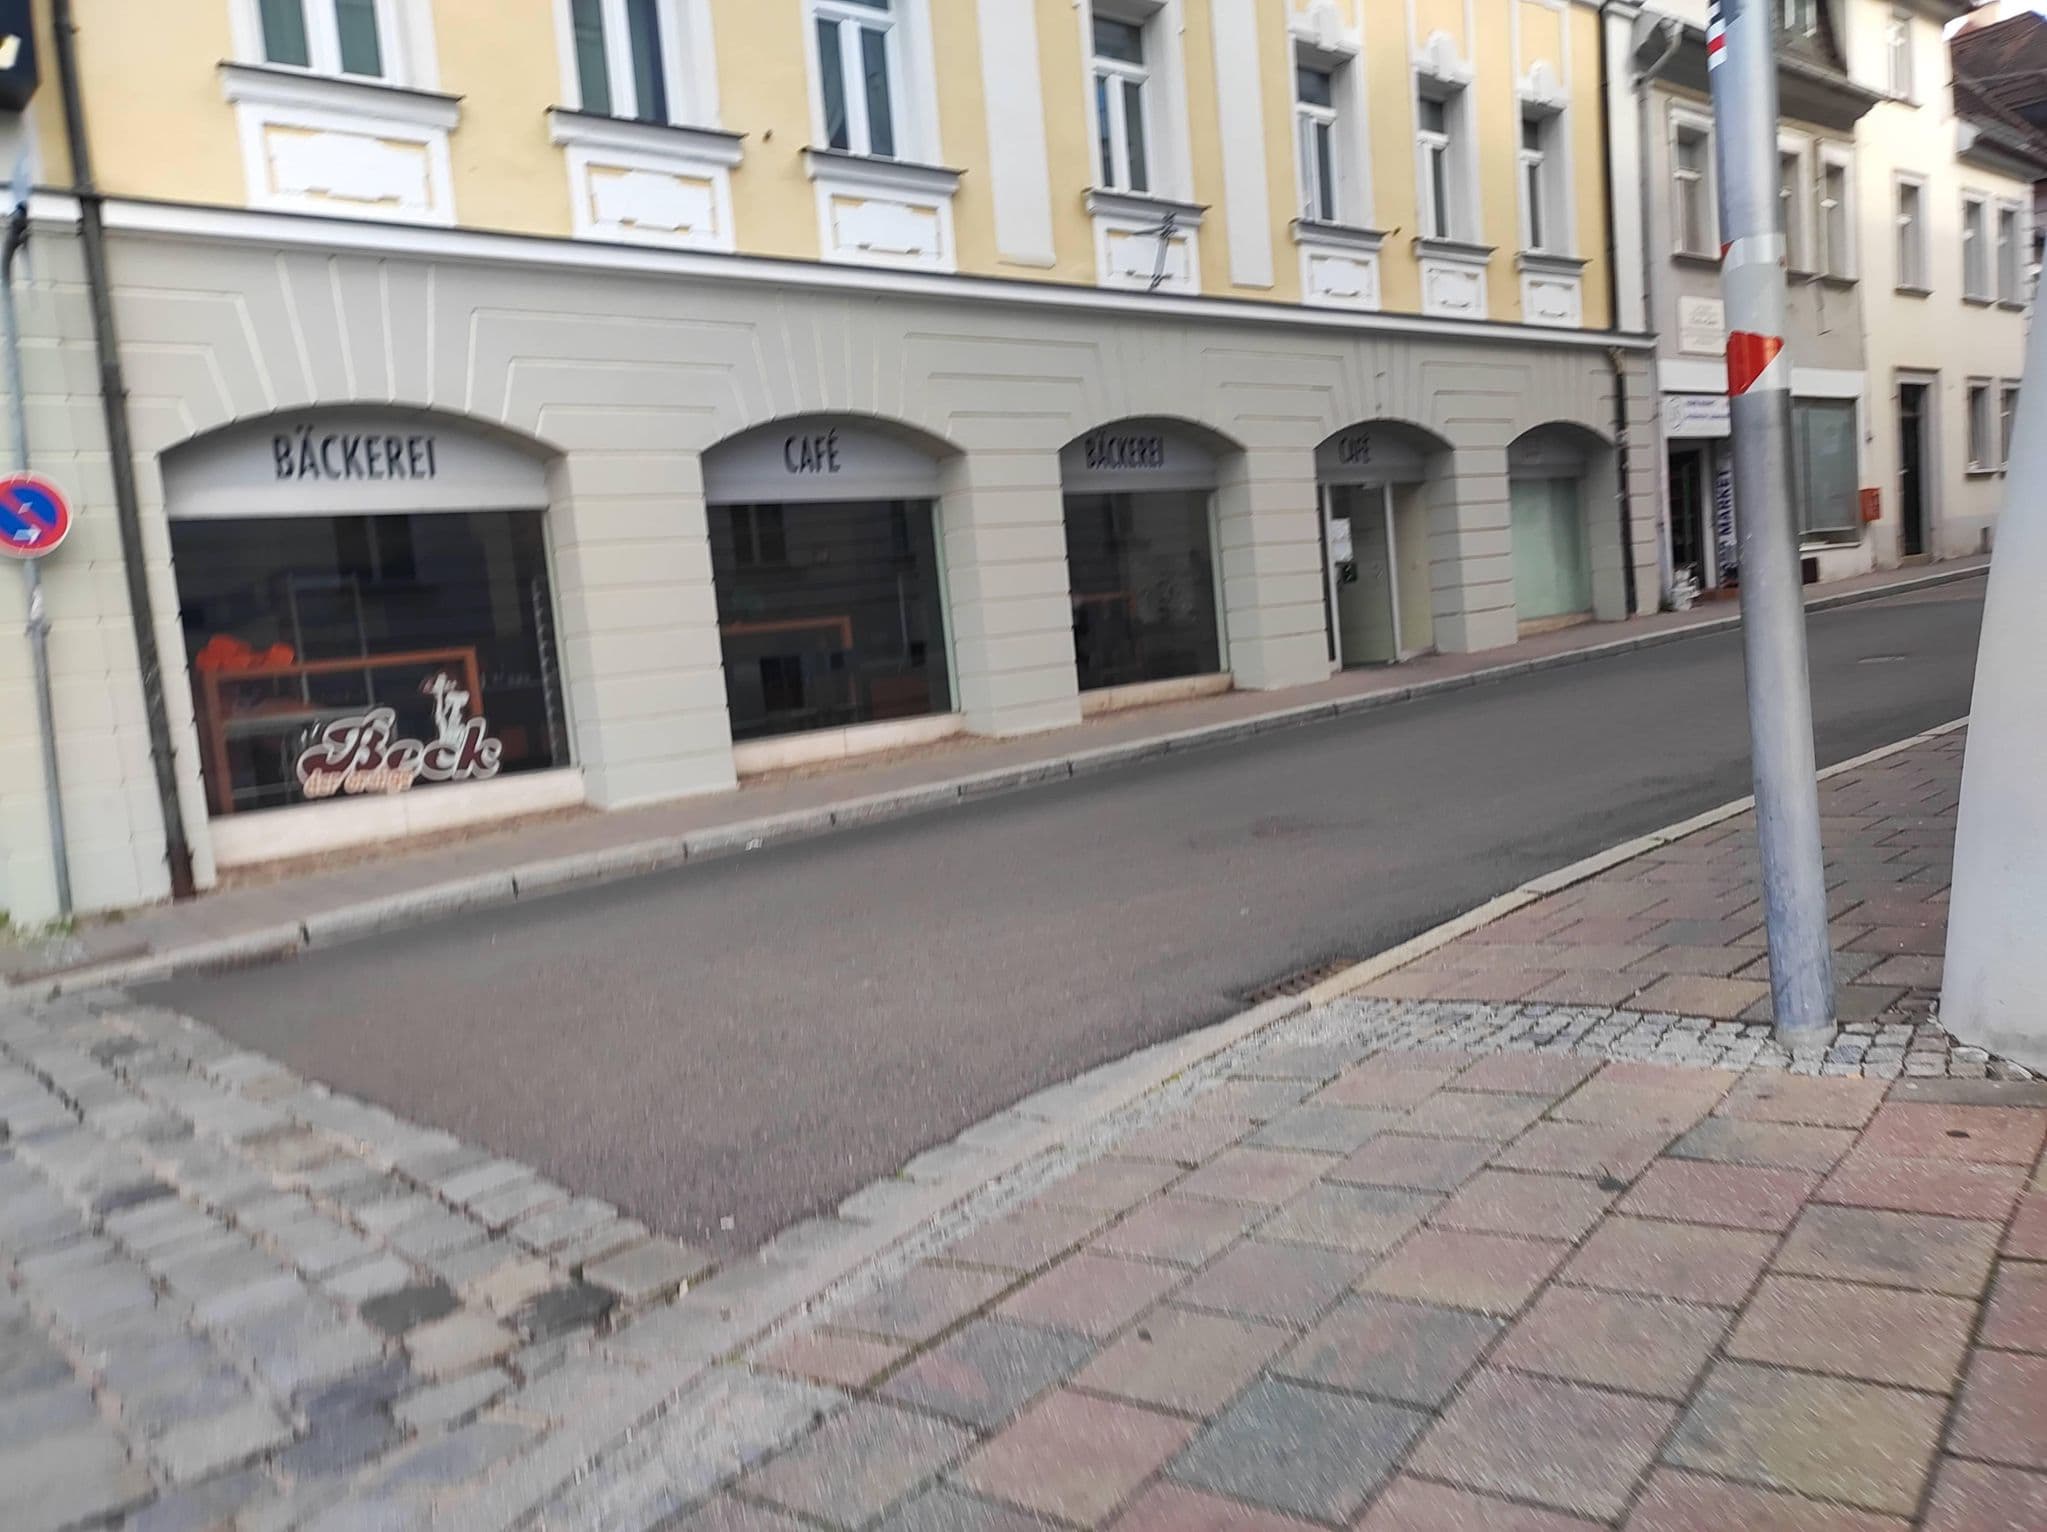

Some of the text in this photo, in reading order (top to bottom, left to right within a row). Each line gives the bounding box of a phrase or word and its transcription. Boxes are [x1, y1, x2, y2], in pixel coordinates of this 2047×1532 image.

[272, 424, 437, 480] BÄCKEREI
[784, 427, 841, 473] CAFÉ
[1085, 431, 1163, 469] BÄCKEREI
[297, 708, 502, 783] Beck
